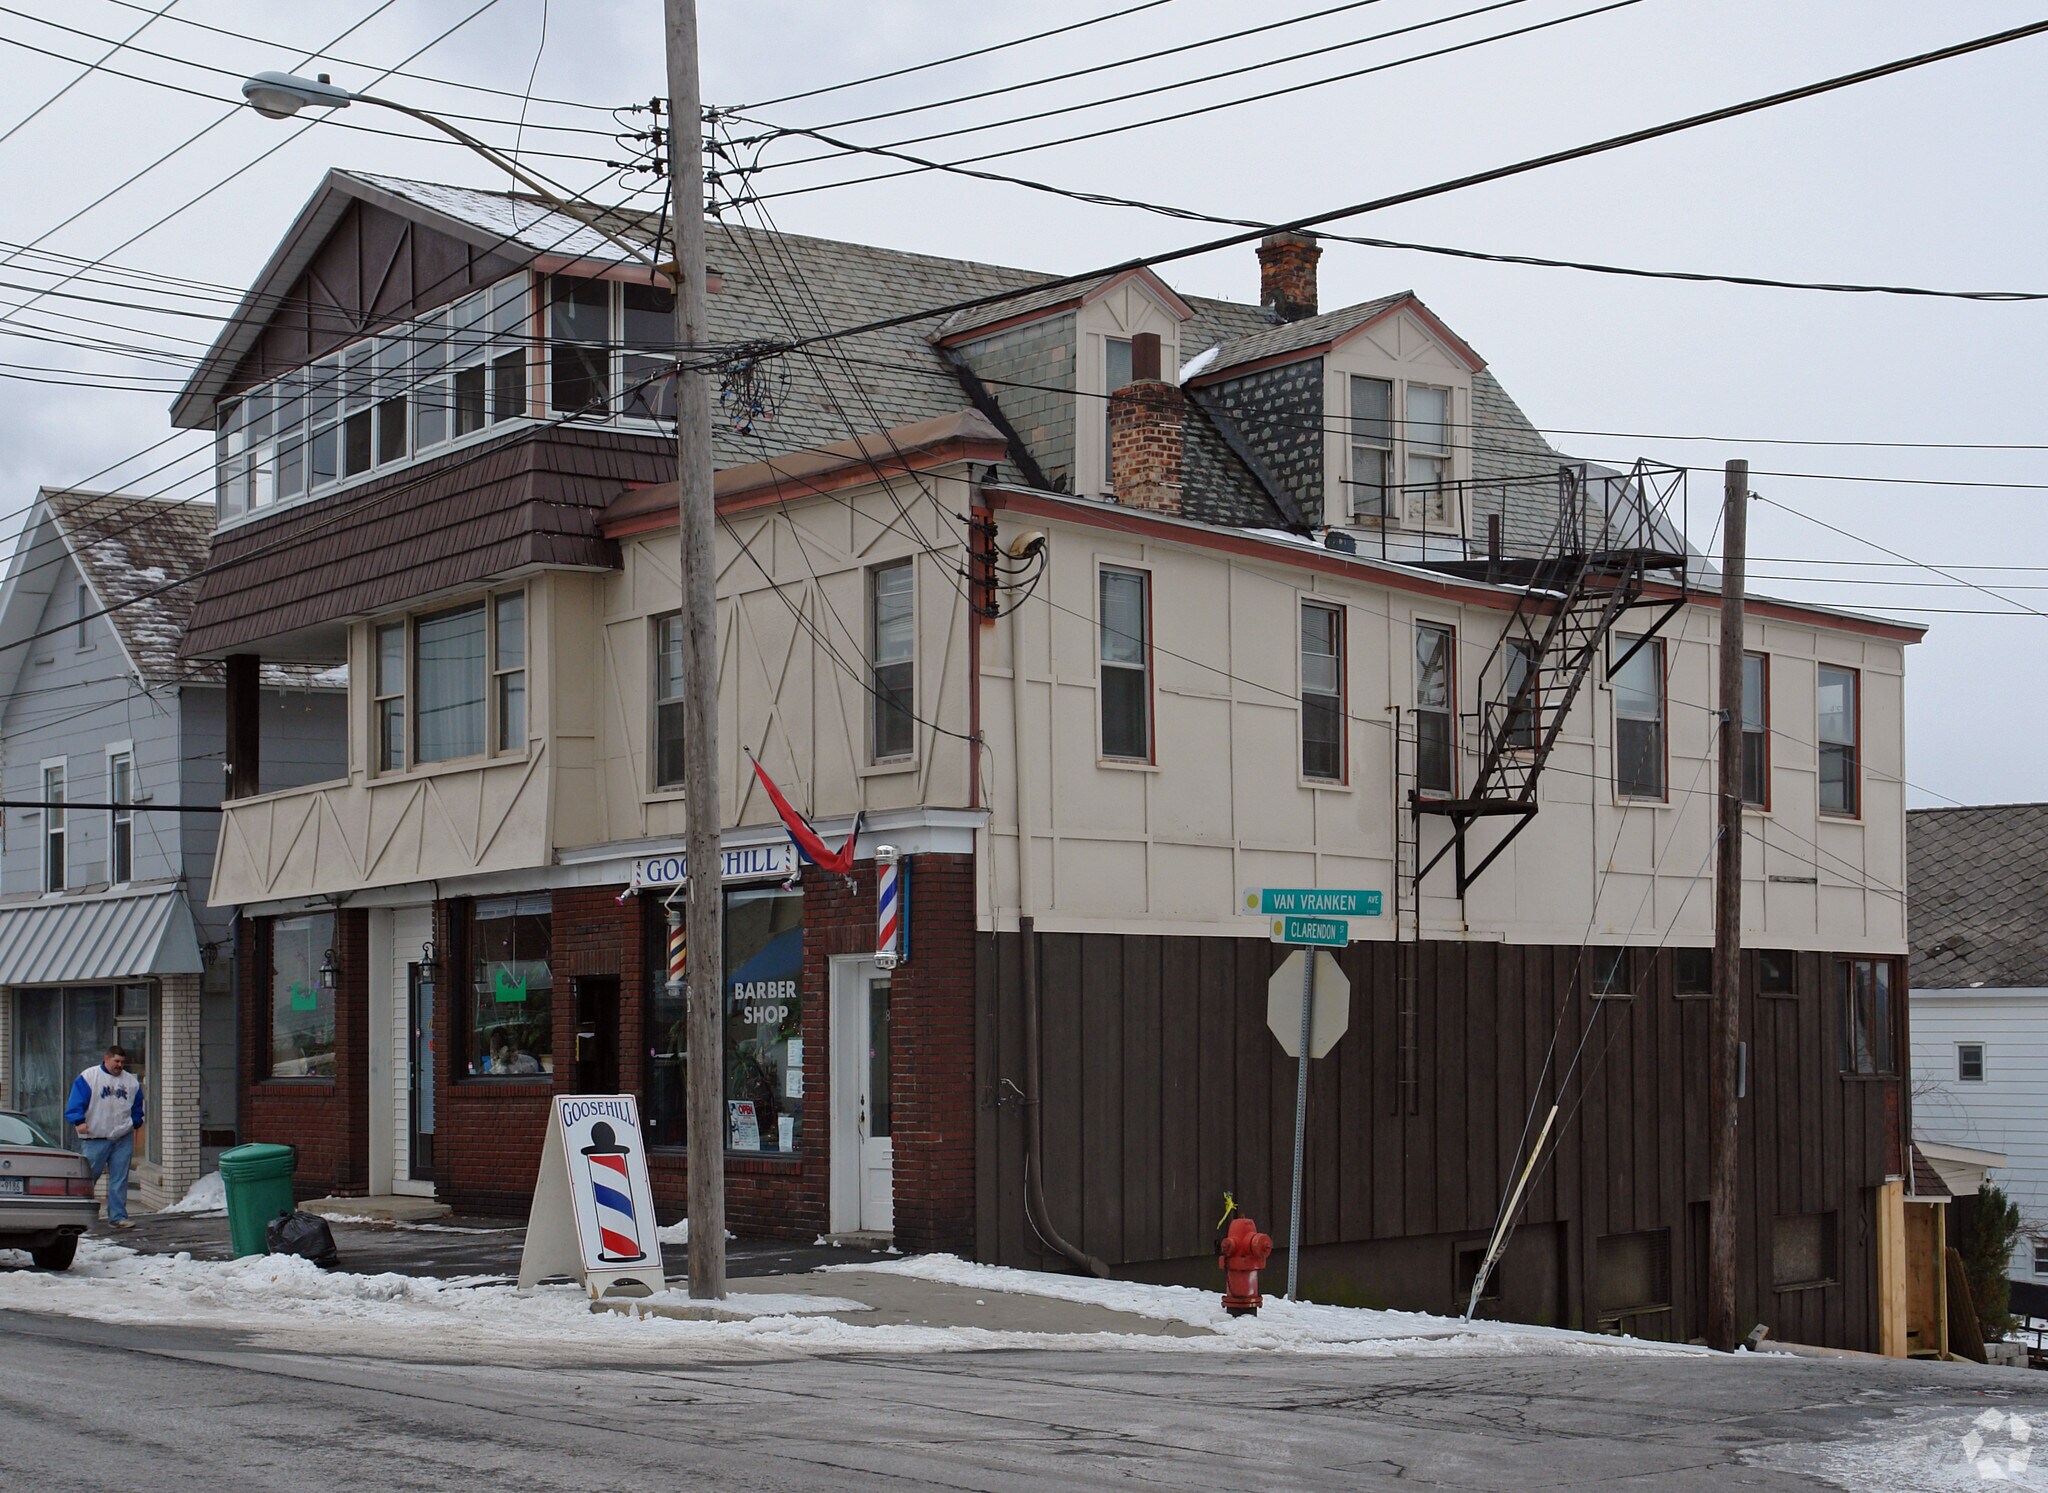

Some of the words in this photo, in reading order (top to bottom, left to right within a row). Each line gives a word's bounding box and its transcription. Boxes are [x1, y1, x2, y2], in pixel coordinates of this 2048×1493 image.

[647, 848, 779, 882] GOHILL
[1273, 894, 1295, 909] VAN
[1301, 894, 1356, 911] VRANKEN
[1367, 895, 1379, 904] AVE
[1291, 922, 1336, 940] CLARENDON
[734, 980, 797, 1000] BARBER
[743, 1005, 789, 1024] SHOP
[562, 1101, 635, 1127] GOOSEHILL
[738, 1104, 754, 1115] OPEN
